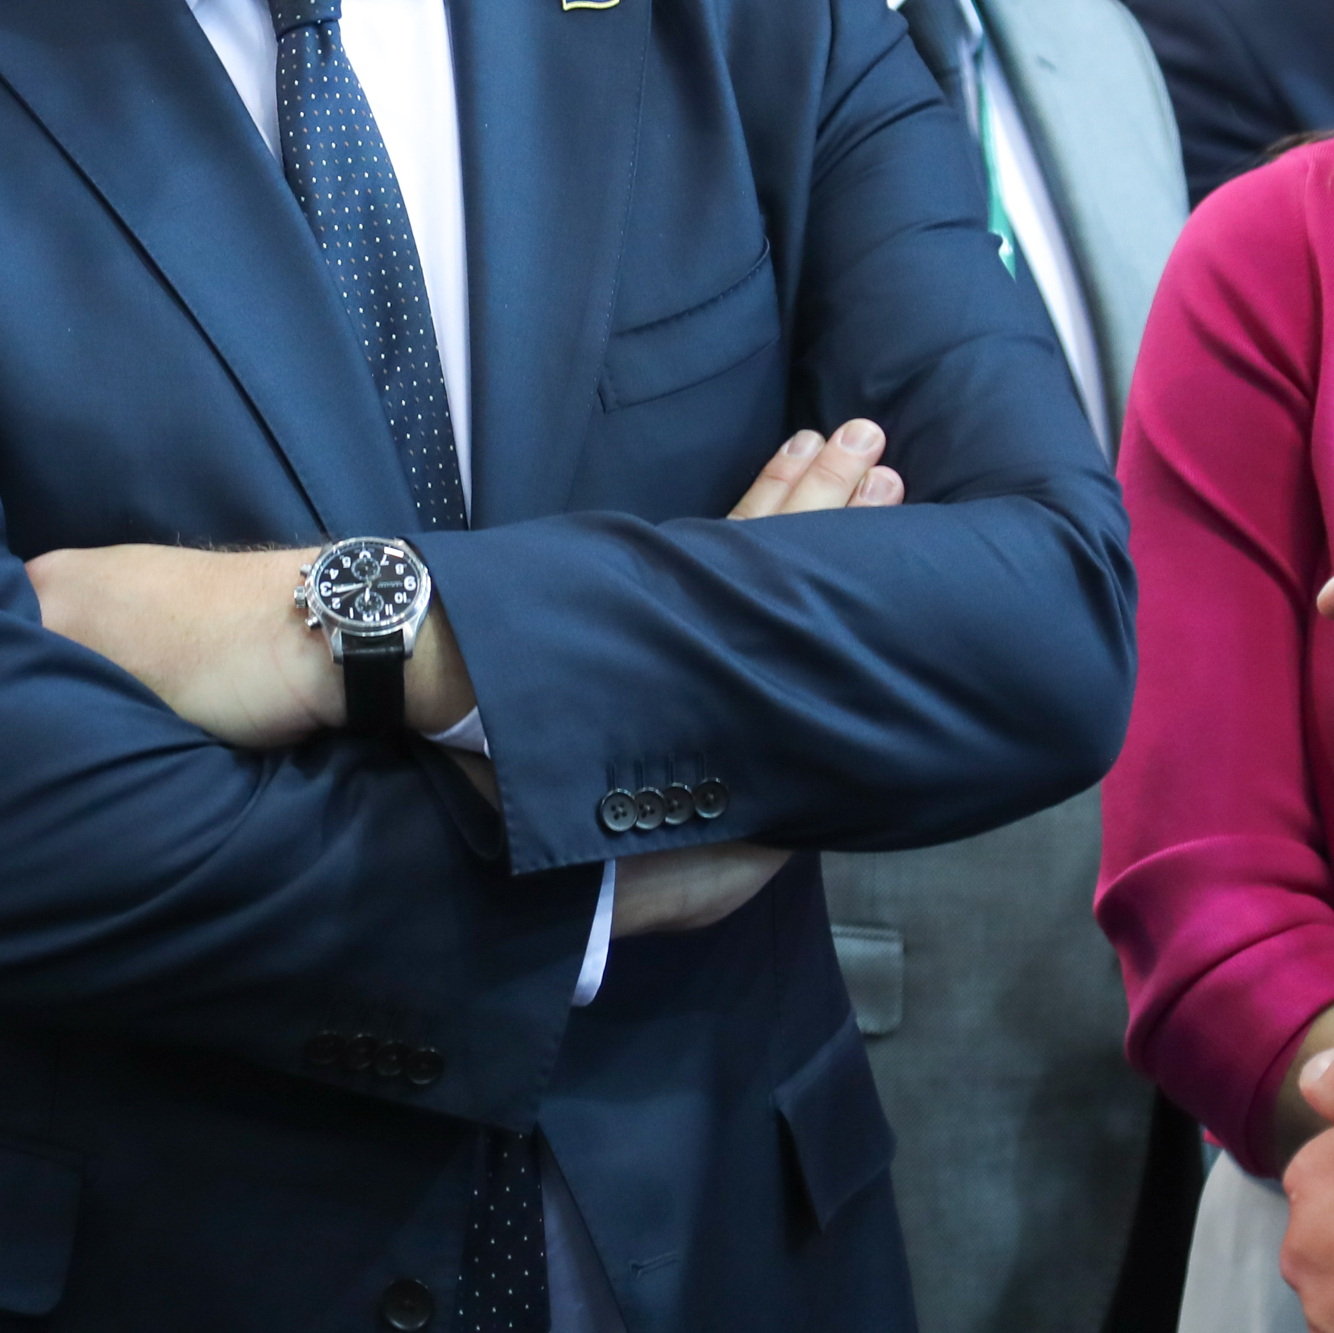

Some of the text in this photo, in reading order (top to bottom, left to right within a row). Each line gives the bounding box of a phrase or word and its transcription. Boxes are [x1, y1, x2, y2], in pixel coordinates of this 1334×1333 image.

[380, 554, 389, 566] 7
[329, 568, 339, 580] 4
[404, 575, 416, 590] 9
[319, 582, 332, 597] 3
[331, 597, 341, 610] 2
[394, 592, 407, 604] 10
[385, 603, 394, 616] 11
